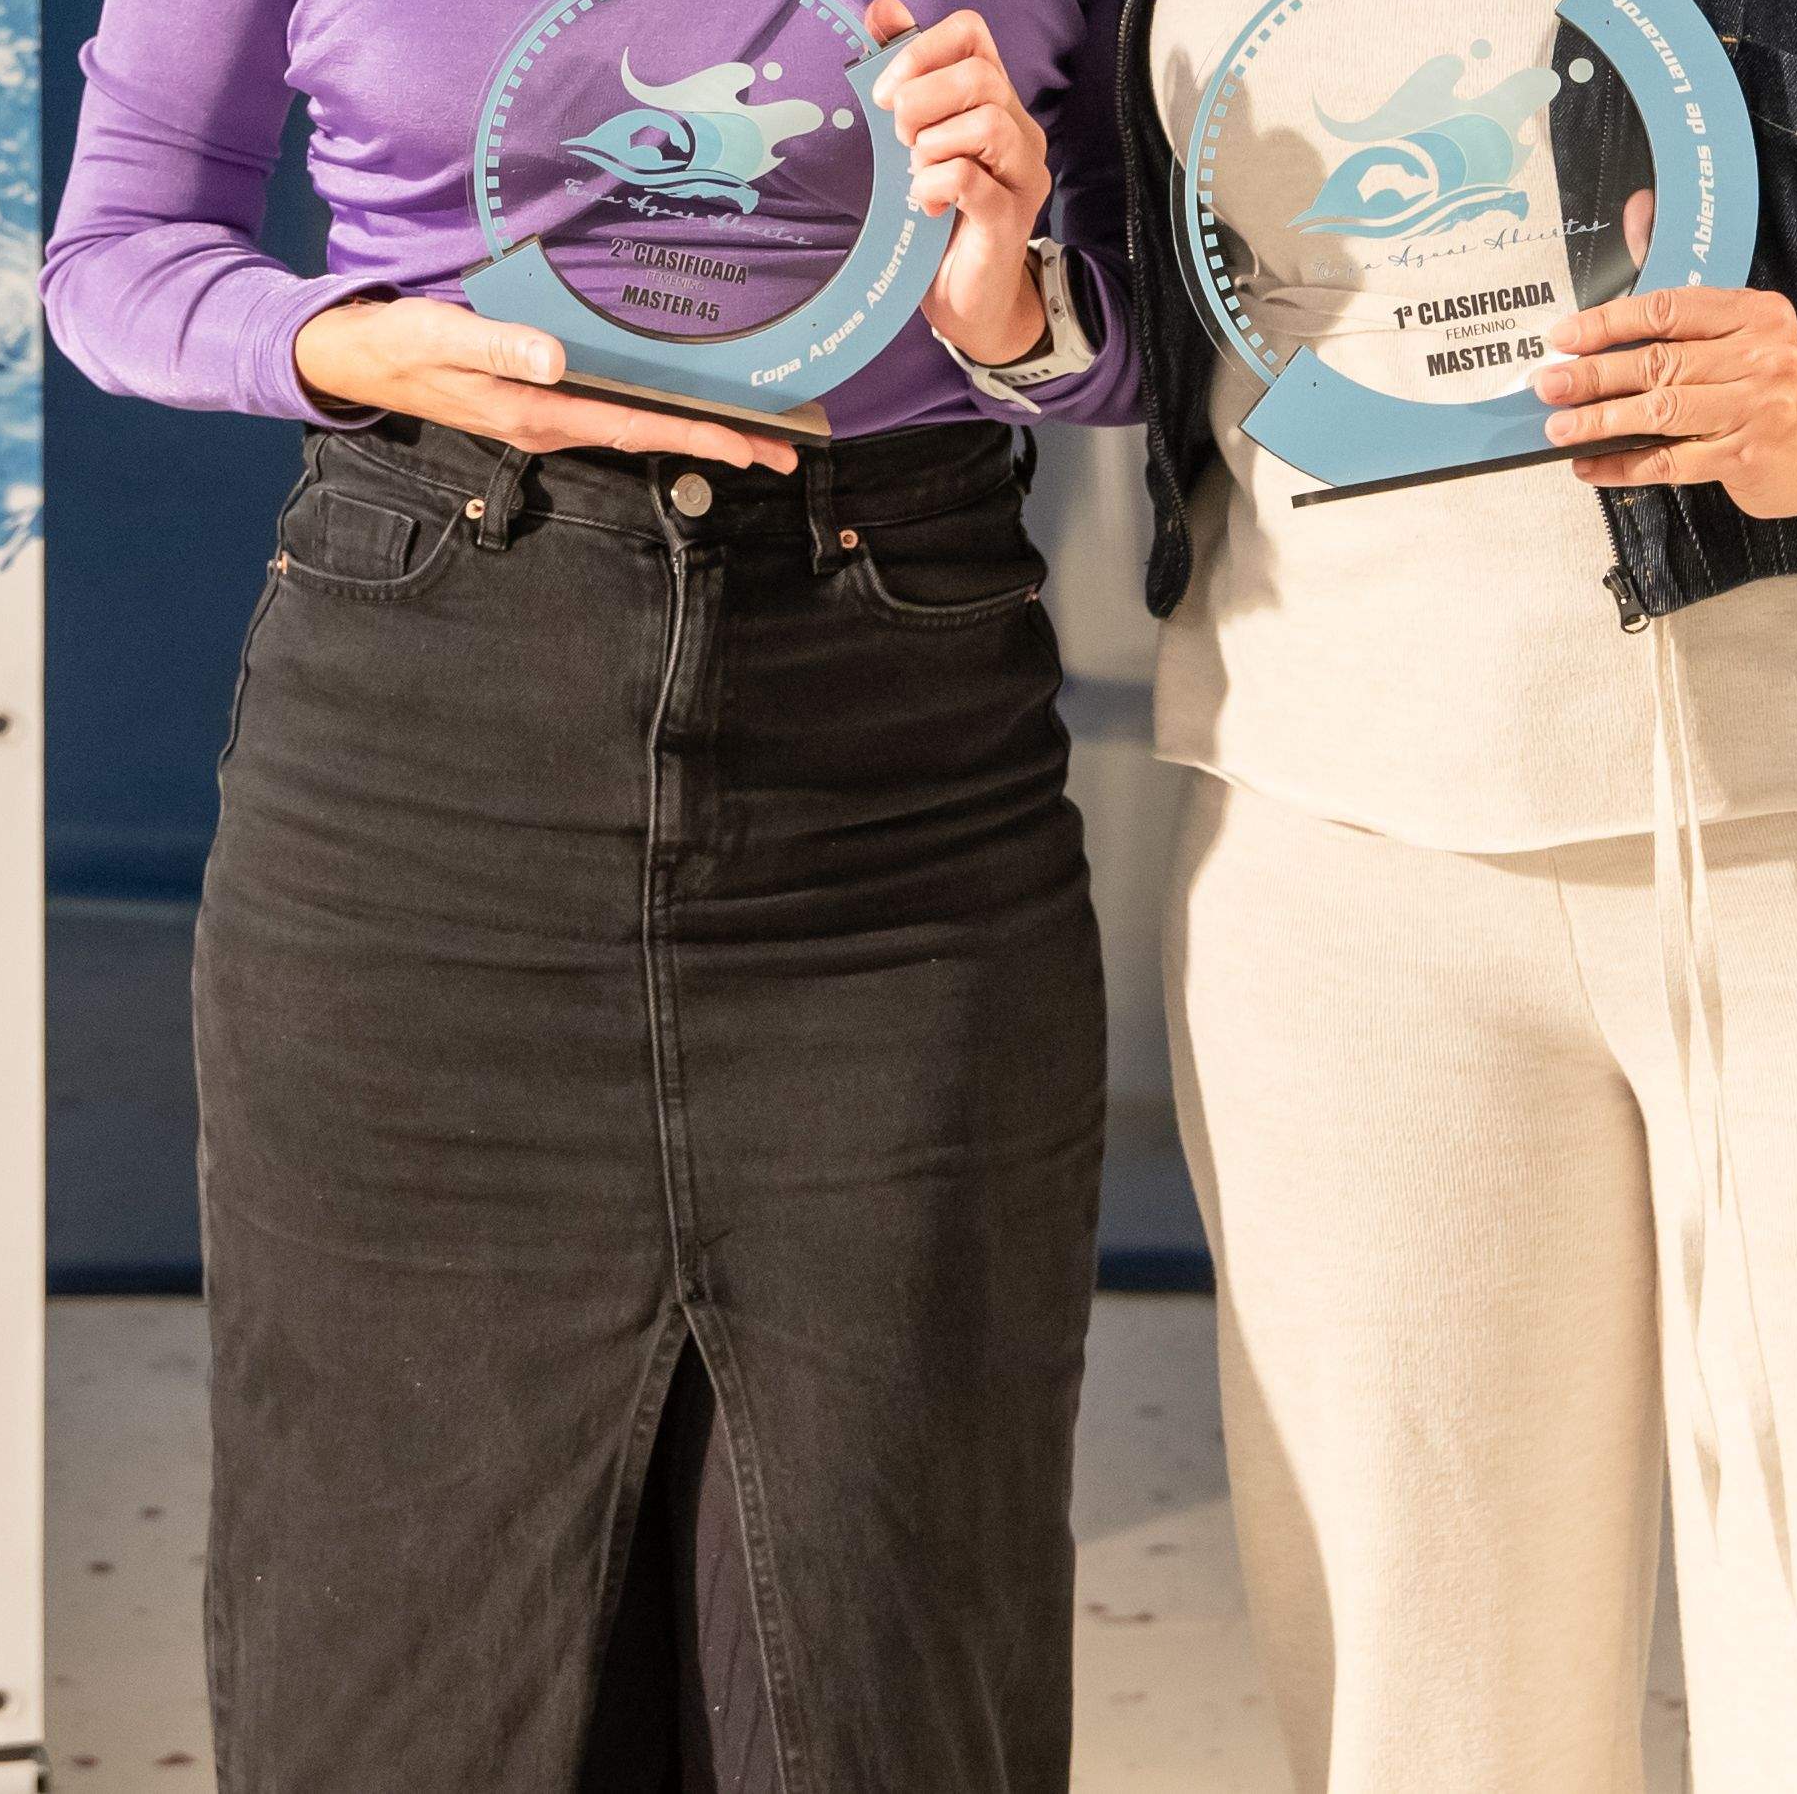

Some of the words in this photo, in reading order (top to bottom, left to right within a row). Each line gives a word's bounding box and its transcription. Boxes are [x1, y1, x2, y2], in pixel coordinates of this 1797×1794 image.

[1686, 102, 1706, 135] de
[1691, 144, 1715, 264] Abiertas
[634, 243, 747, 285] CLASIFICADA
[621, 284, 693, 317] MASTER
[695, 301, 720, 322] 45
[751, 358, 802, 387] Copa
[809, 310, 865, 362] Aguas
[866, 219, 916, 309] Abiertas
[1418, 281, 1555, 325] CLASIFICADA
[1445, 318, 1516, 341] FEMENINO
[1427, 342, 1513, 377] MASTER
[1516, 335, 1545, 360] 45
